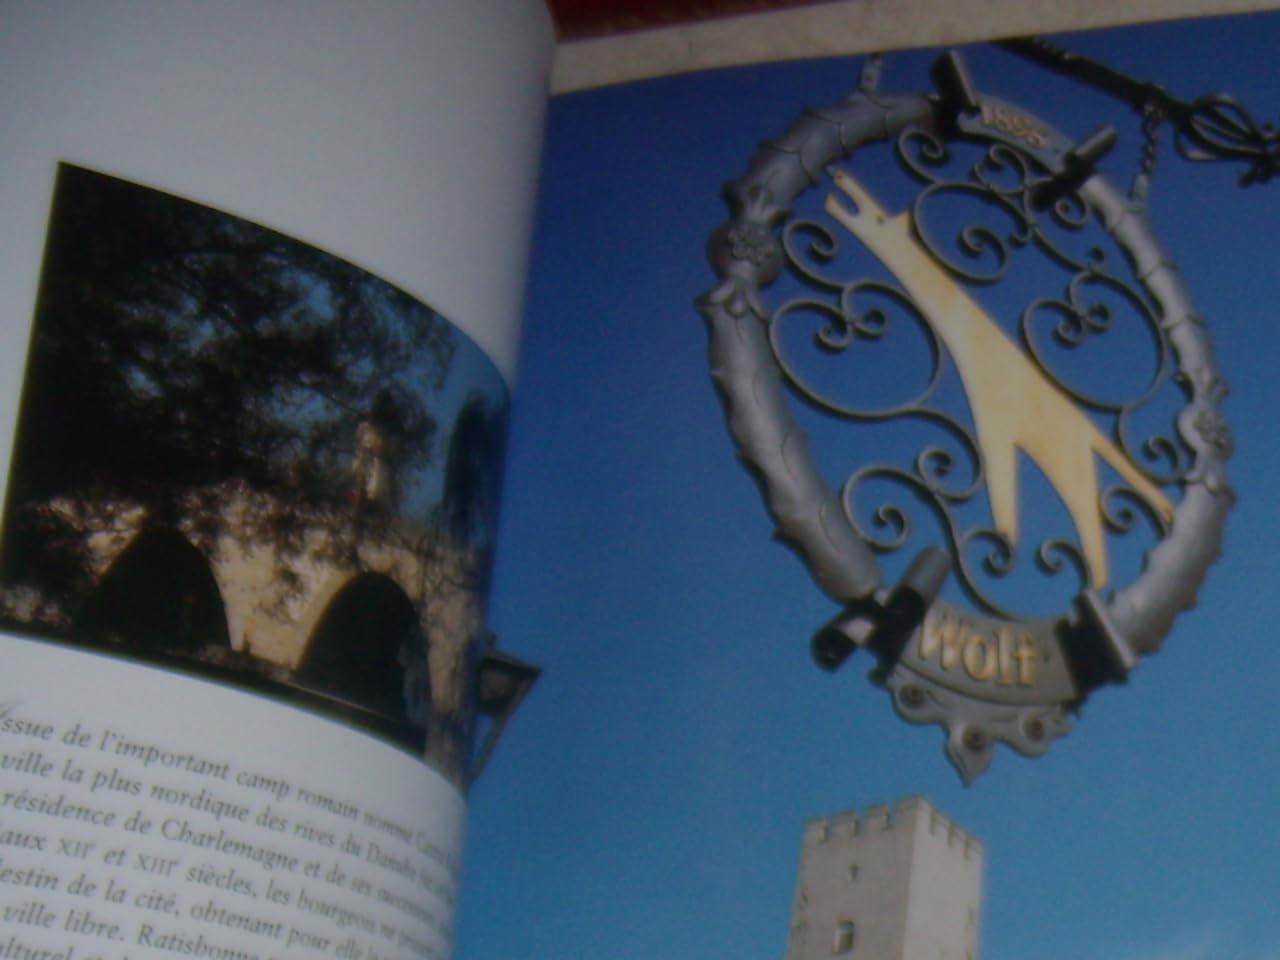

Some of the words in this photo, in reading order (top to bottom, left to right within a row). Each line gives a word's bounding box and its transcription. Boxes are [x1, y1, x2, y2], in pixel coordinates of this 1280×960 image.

[0, 750, 54, 779] ville
[61, 758, 85, 785] la
[90, 768, 142, 797] plus
[149, 783, 249, 823] nordique
[255, 804, 289, 833] des
[293, 822, 336, 849] rives
[61, 722, 92, 748] de
[99, 729, 230, 781] l'important
[235, 770, 290, 802] camp
[296, 786, 360, 821] romain
[0, 829, 48, 852] aux
[103, 847, 129, 867] et
[264, 878, 291, 907] les
[1, 788, 117, 828] résidence
[124, 808, 153, 835] de
[160, 818, 299, 874] Charlemagne
[303, 862, 322, 880] et
[325, 863, 347, 888] de
[0, 862, 60, 892] estin
[67, 872, 98, 898] de
[104, 878, 127, 905] la
[134, 889, 181, 919] cité,
[189, 899, 284, 941] obtenant
[286, 926, 331, 952] pour
[2, 902, 56, 929] ville
[64, 908, 126, 943] libre.
